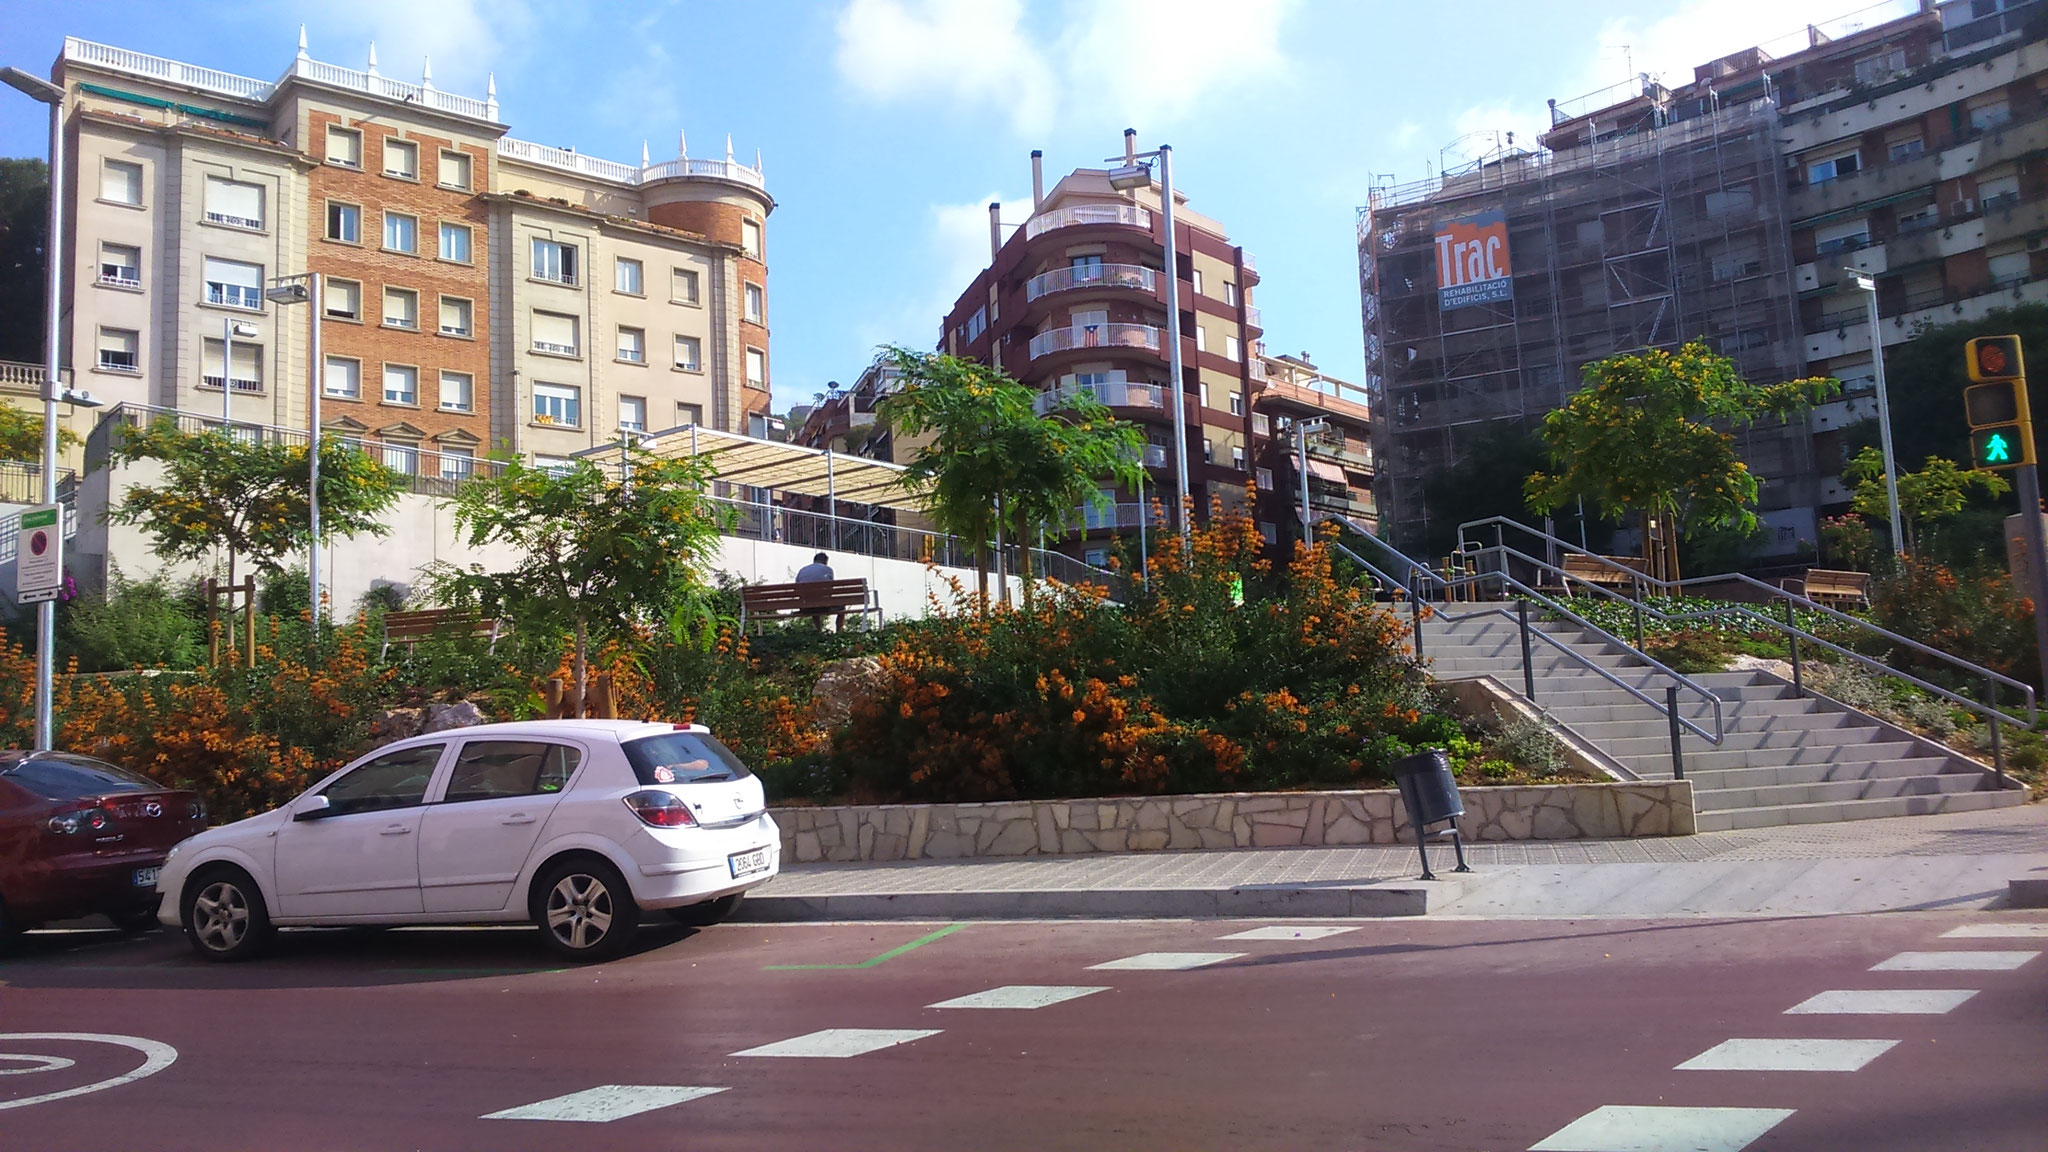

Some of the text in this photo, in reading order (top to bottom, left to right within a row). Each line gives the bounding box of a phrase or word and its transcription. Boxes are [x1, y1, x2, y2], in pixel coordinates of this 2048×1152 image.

[1435, 234, 1503, 288] Trac
[1444, 290, 1508, 306] D'EDIFICIS, S.L.
